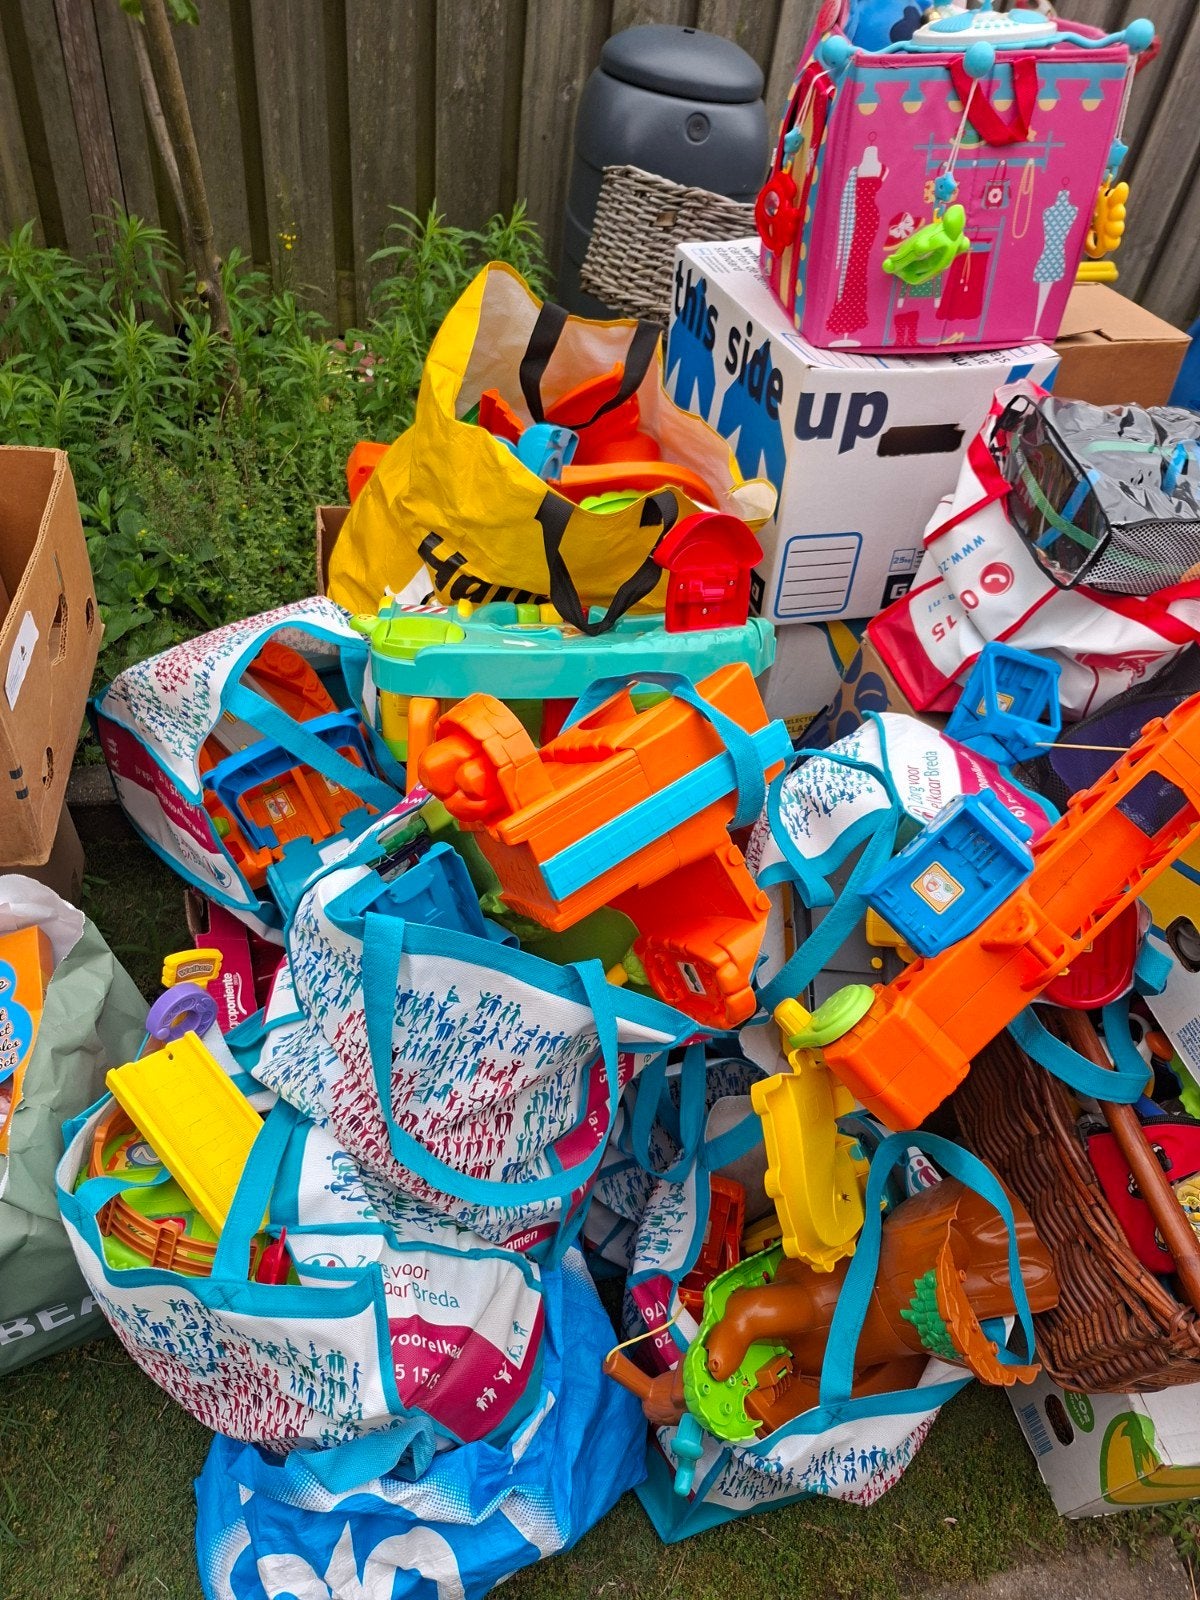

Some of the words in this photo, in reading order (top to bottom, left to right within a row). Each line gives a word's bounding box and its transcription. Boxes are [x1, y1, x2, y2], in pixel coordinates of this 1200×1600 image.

[674, 260, 719, 352] this
[725, 321, 784, 421] side
[794, 390, 889, 454] up
[907, 765, 921, 784] voor
[922, 750, 941, 777] Breda
[390, 1262, 430, 1281] voor
[411, 1282, 461, 1309] Breda
